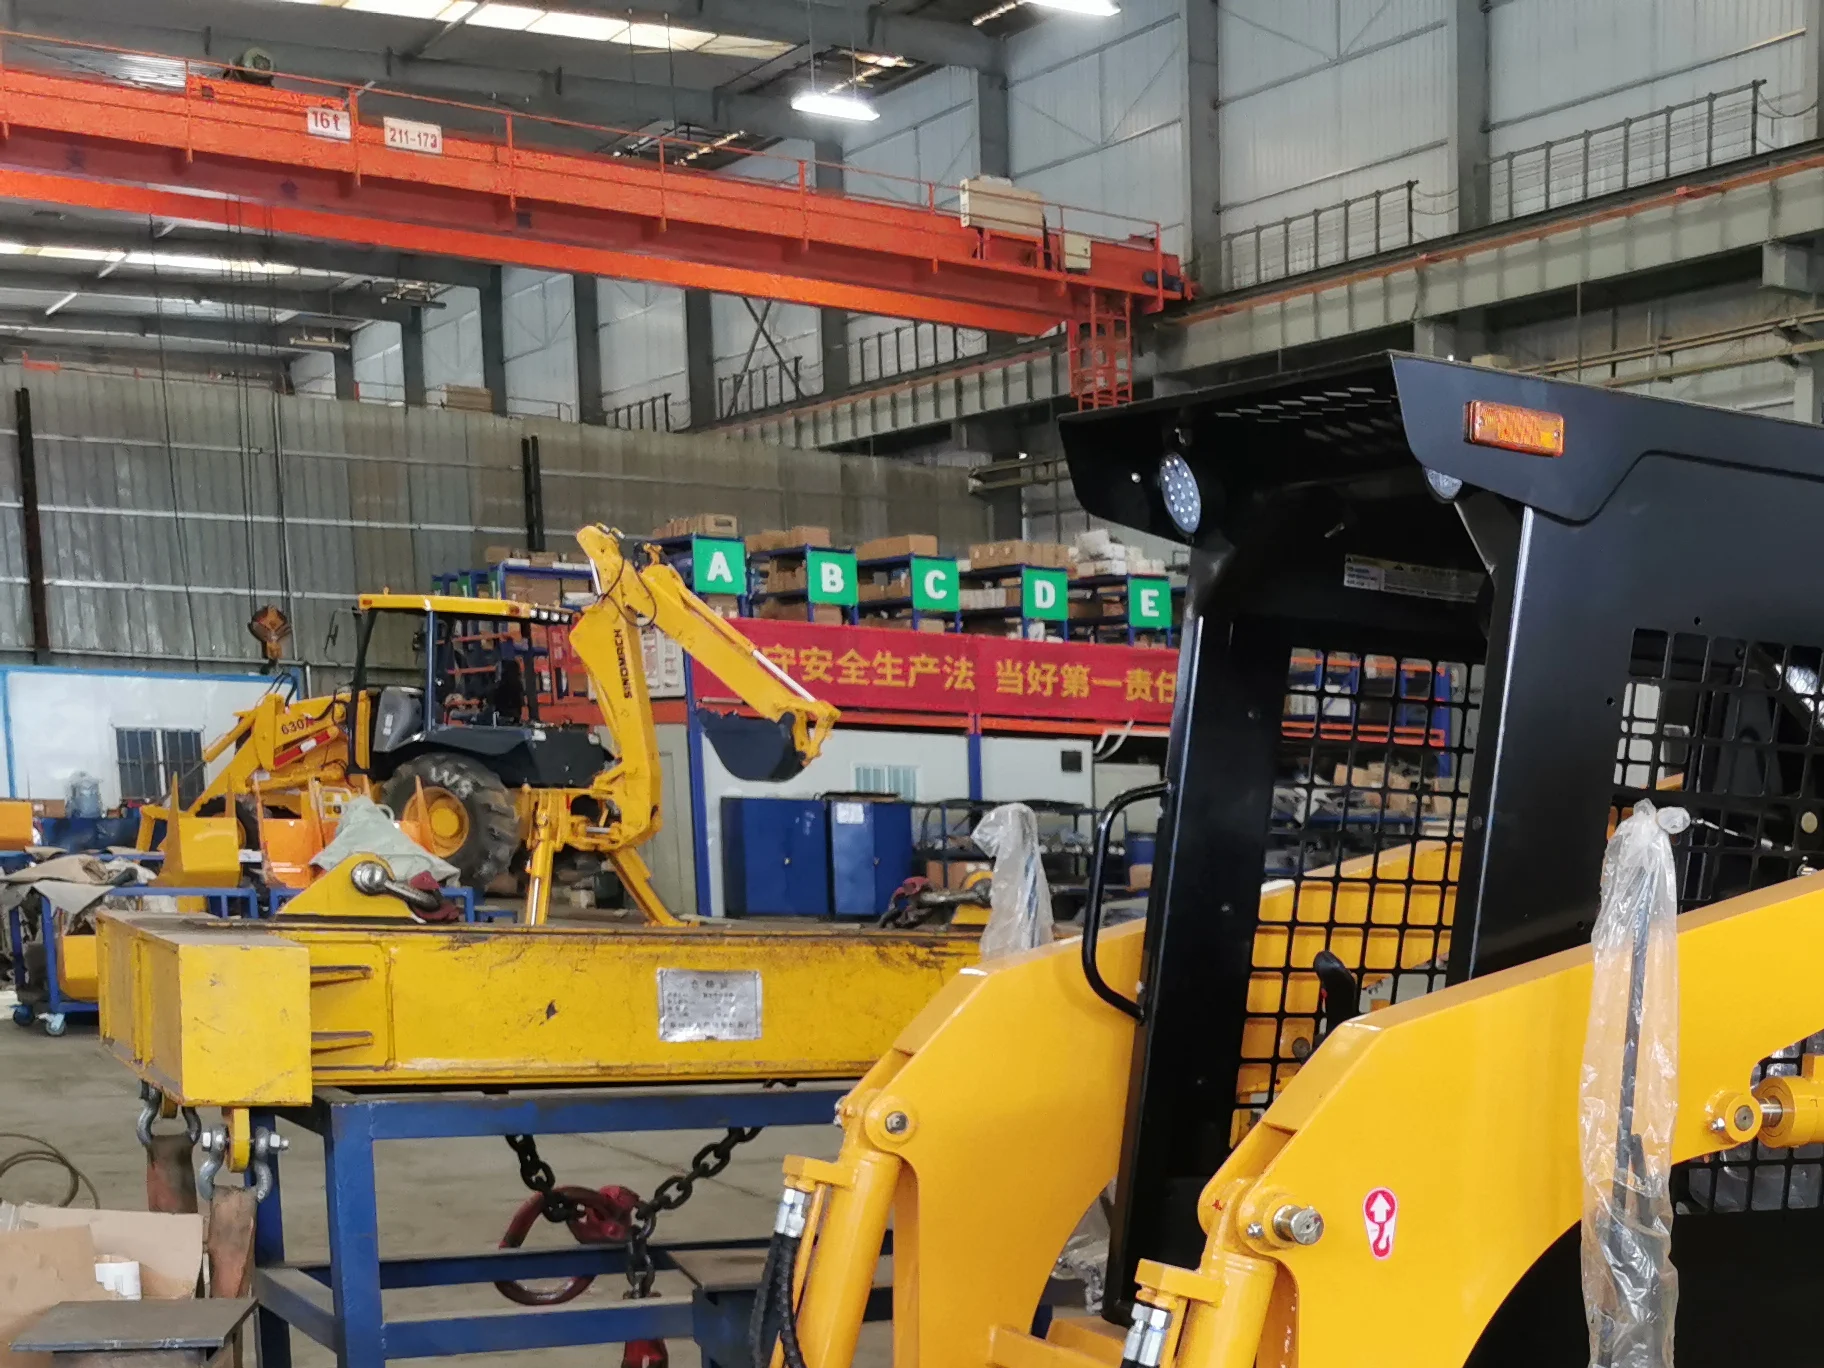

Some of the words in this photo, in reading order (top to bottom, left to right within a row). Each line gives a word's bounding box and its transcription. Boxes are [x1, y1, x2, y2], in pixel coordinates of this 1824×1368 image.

[707, 550, 734, 583] A
[821, 562, 845, 593] B
[924, 569, 948, 600] C
[1035, 579, 1056, 609] D
[1140, 588, 1160, 618] E
